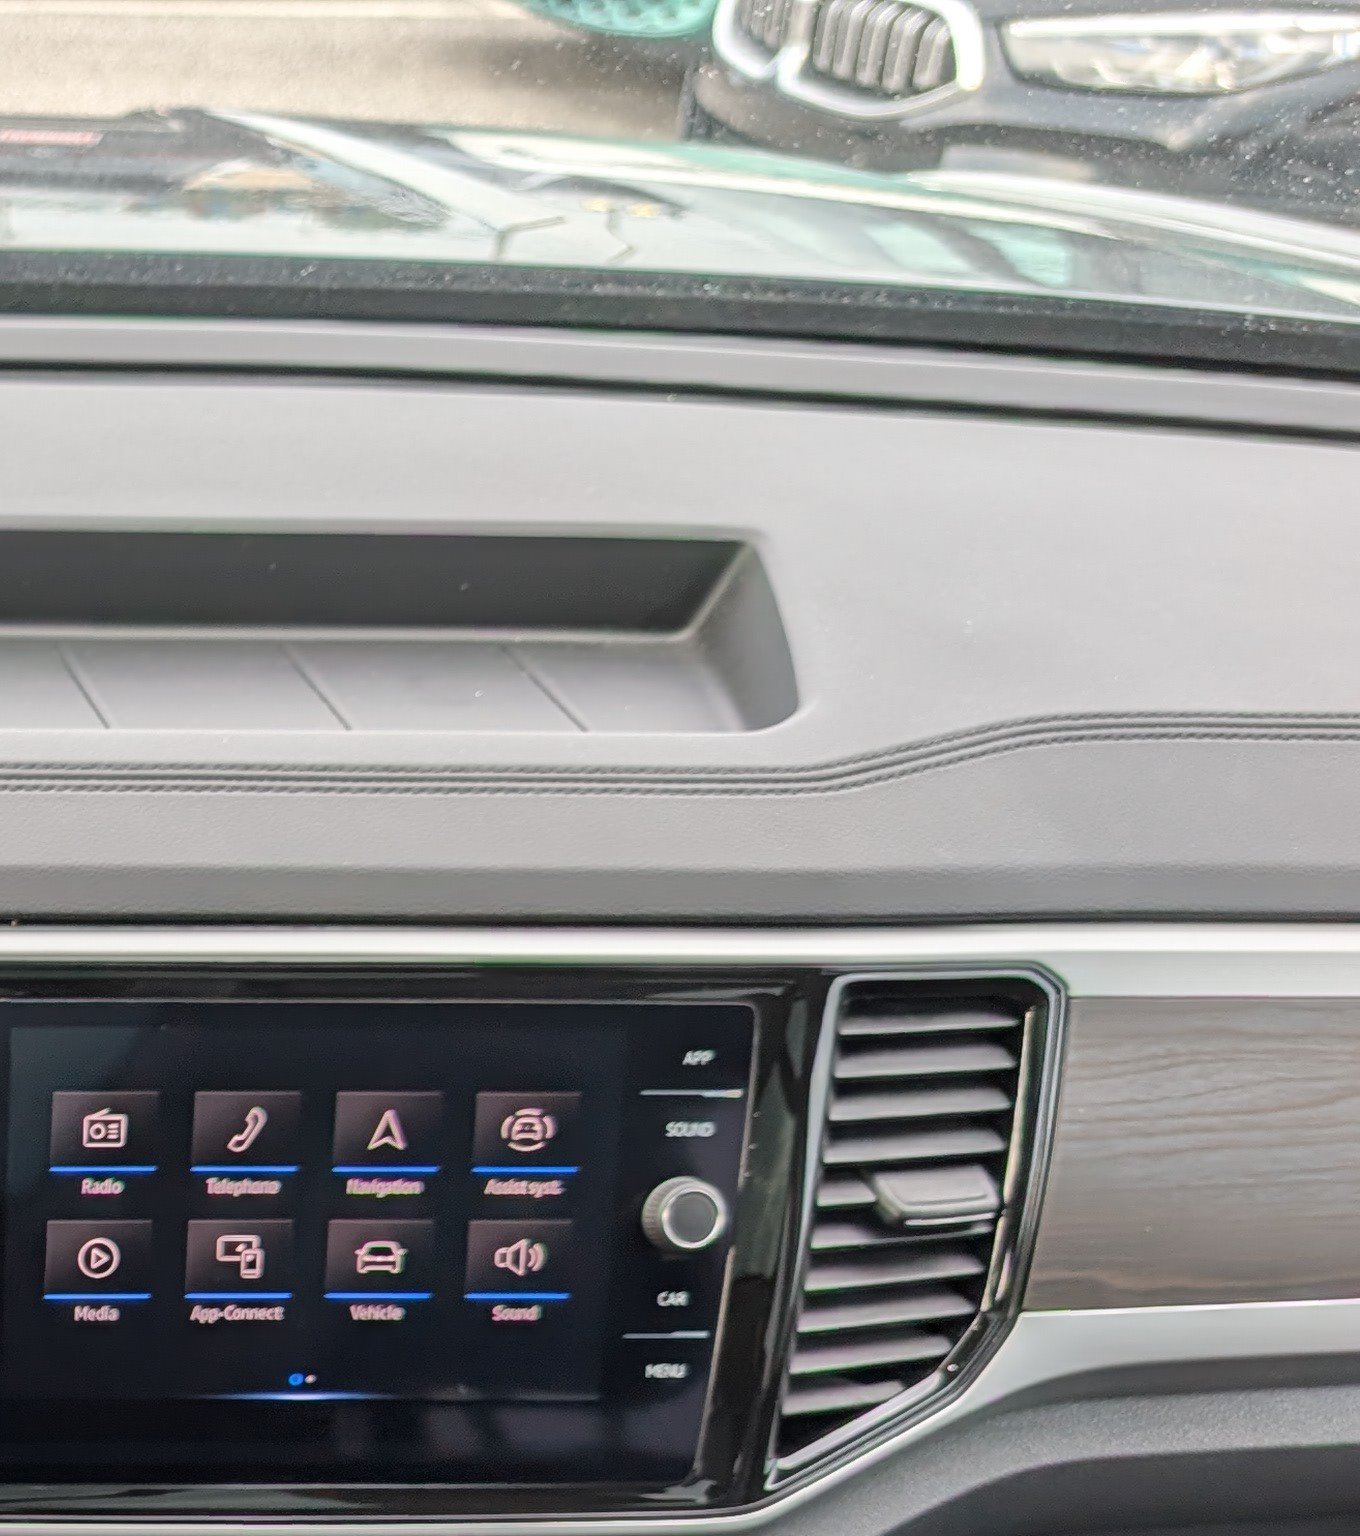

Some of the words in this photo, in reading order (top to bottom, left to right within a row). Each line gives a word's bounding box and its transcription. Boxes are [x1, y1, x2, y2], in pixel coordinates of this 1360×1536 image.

[681, 1050, 716, 1066] APP
[664, 1121, 717, 1138] SOUND
[80, 1177, 125, 1196] Radio
[204, 1178, 282, 1198] Telephone
[345, 1178, 425, 1198] Navigation
[655, 1290, 690, 1308] CAR
[73, 1305, 120, 1323] Media
[188, 1304, 286, 1323] App-Connect
[349, 1304, 406, 1322] Vehicle
[490, 1304, 542, 1322] Sound
[643, 1362, 690, 1380] MENU
